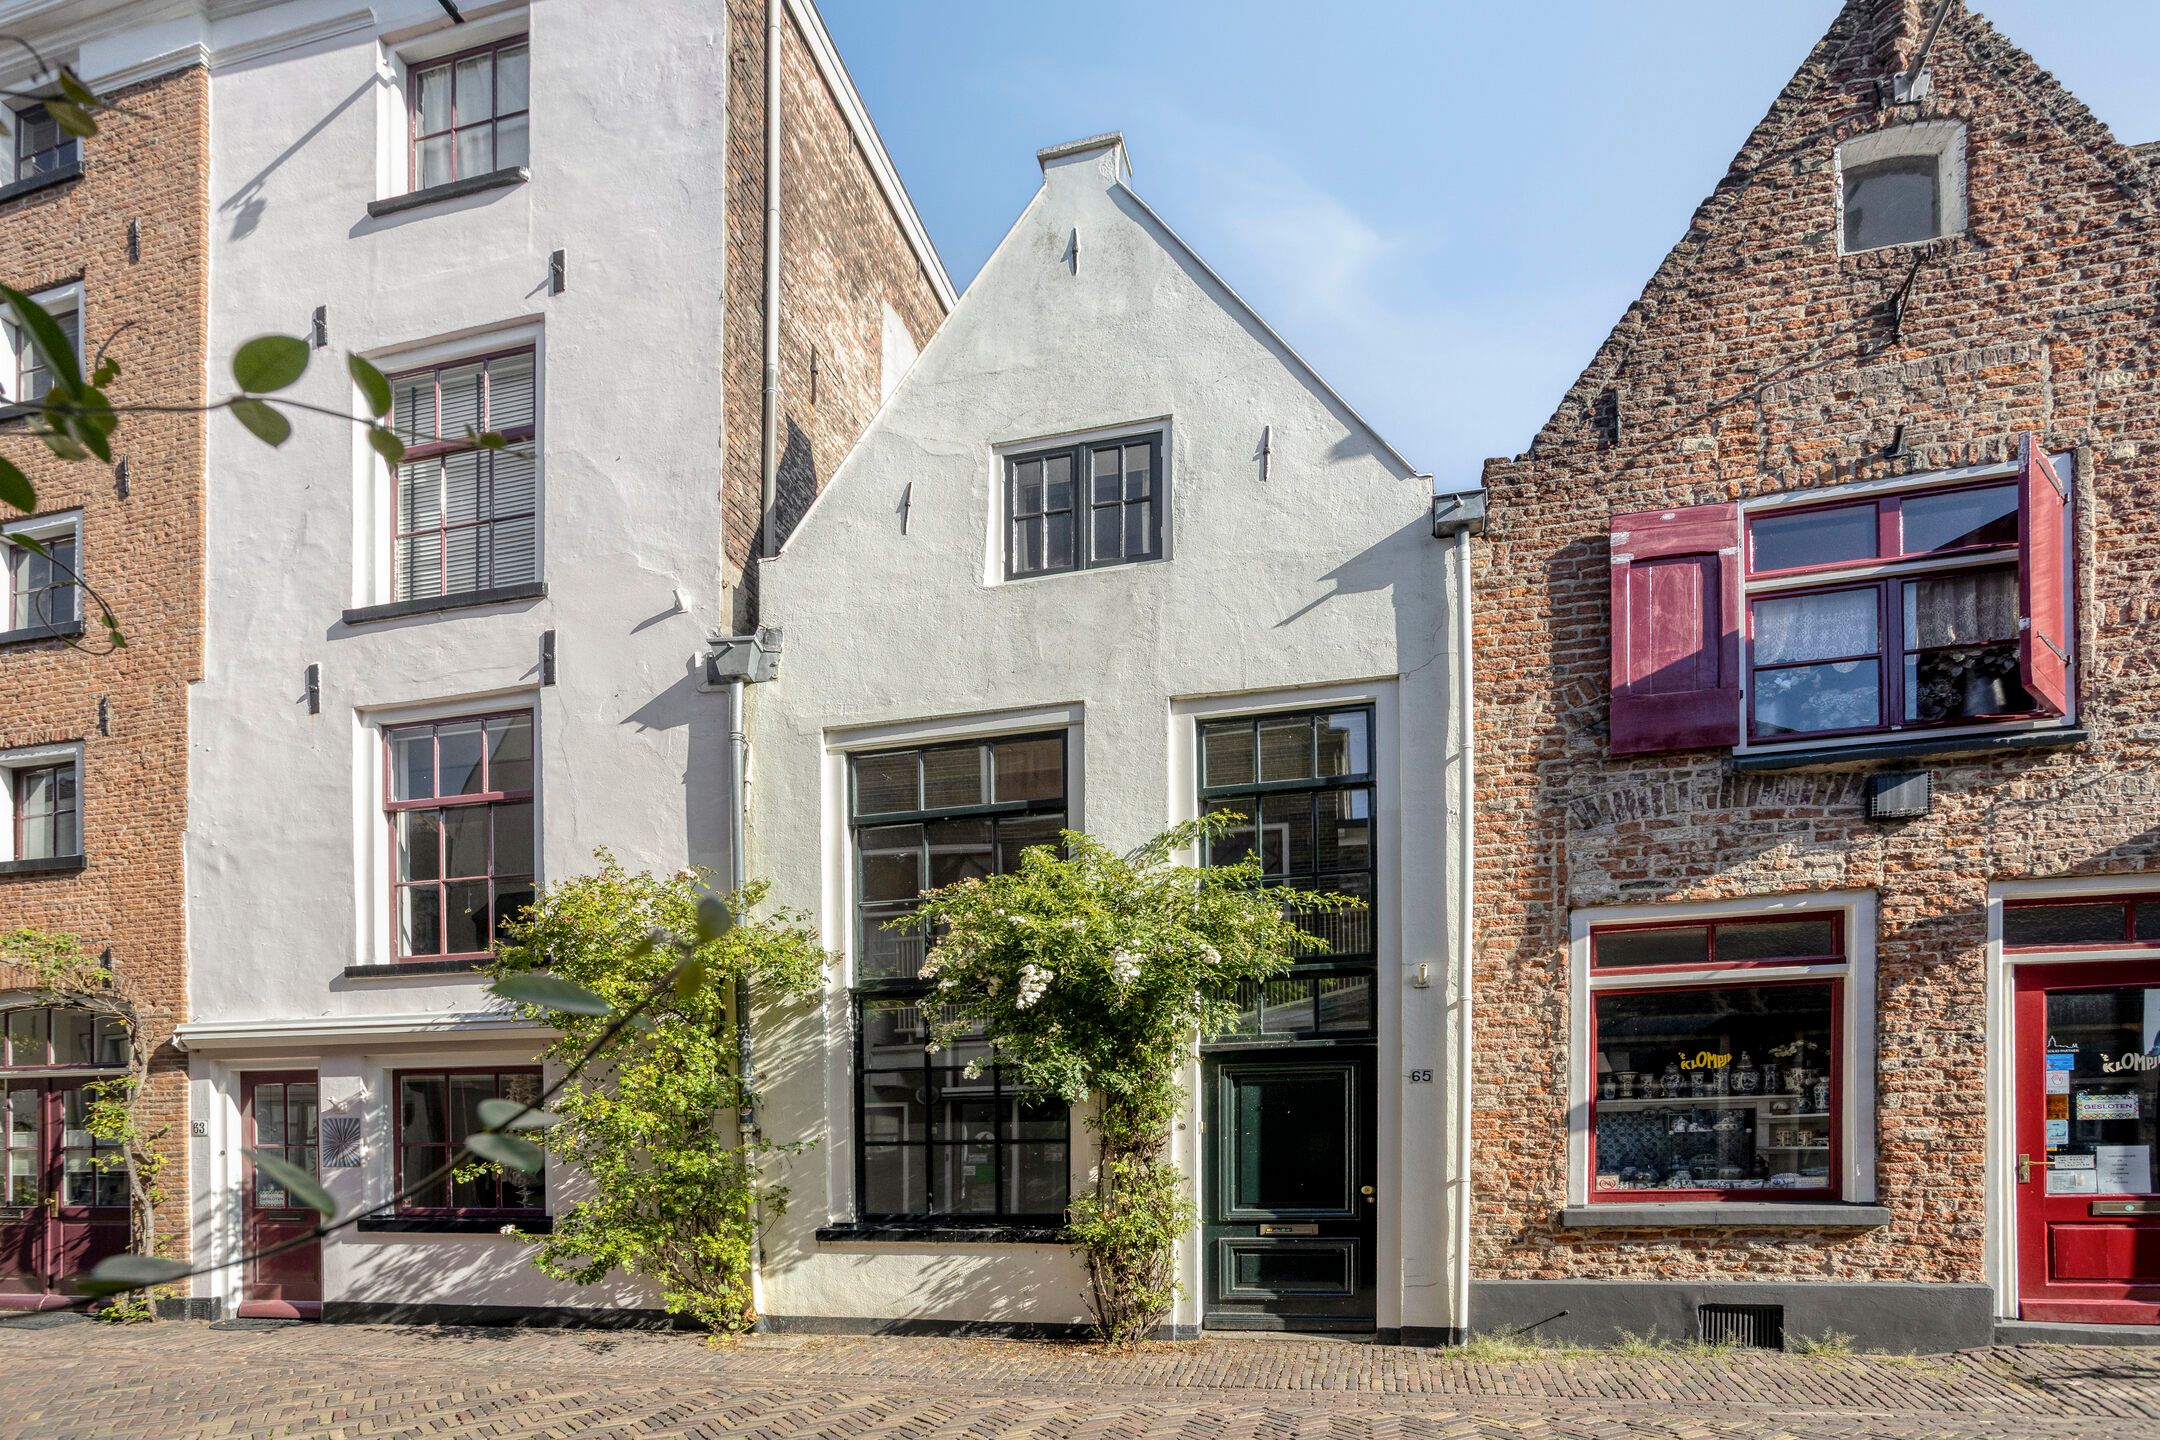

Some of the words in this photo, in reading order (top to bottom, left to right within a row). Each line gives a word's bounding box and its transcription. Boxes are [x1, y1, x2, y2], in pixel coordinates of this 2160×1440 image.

[2102, 1052, 2160, 1073] KLOMPJ
[1412, 1070, 1431, 1082] 65
[193, 1122, 205, 1134] 63
